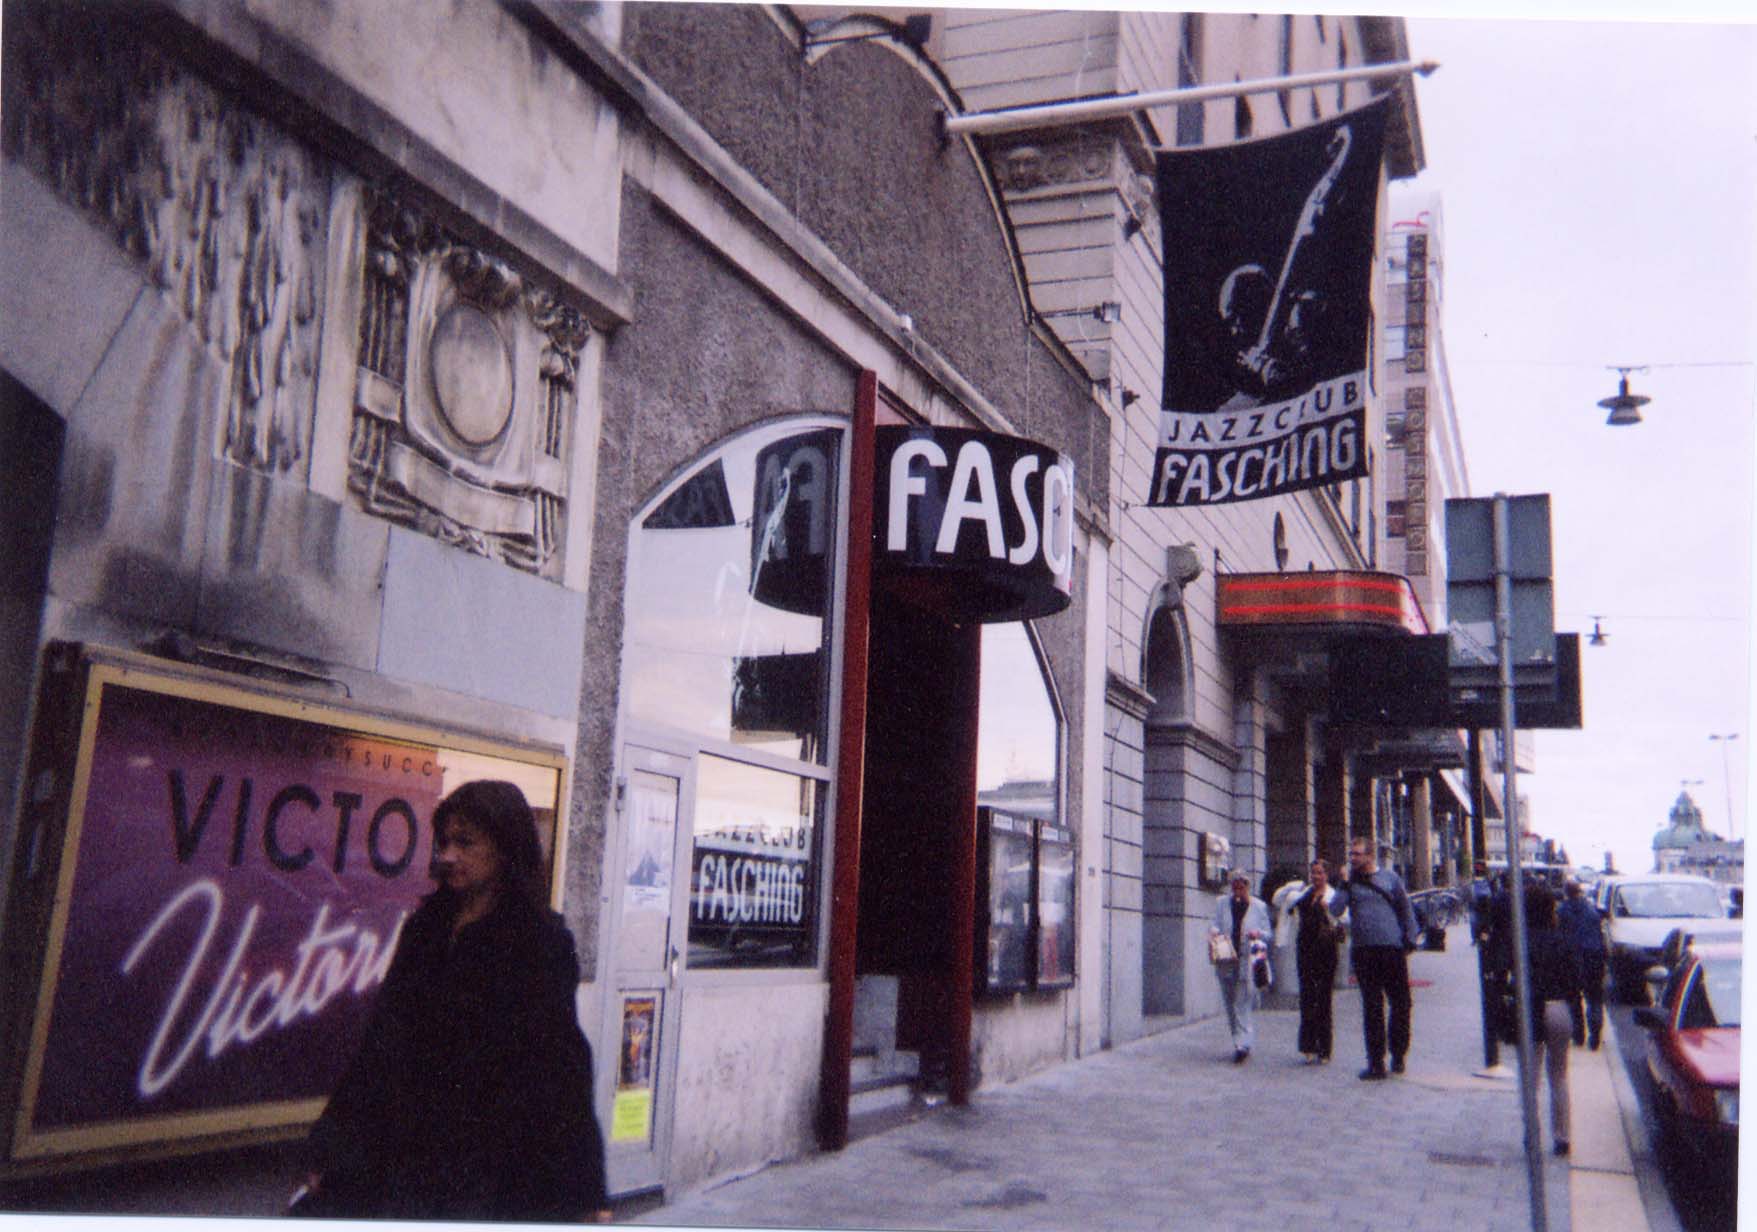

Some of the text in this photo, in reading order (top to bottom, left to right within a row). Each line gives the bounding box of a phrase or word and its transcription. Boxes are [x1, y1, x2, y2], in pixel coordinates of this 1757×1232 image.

[1156, 417, 1357, 504] FASCHING
[168, 767, 419, 879] VICTO
[697, 854, 805, 923] FASCHING
